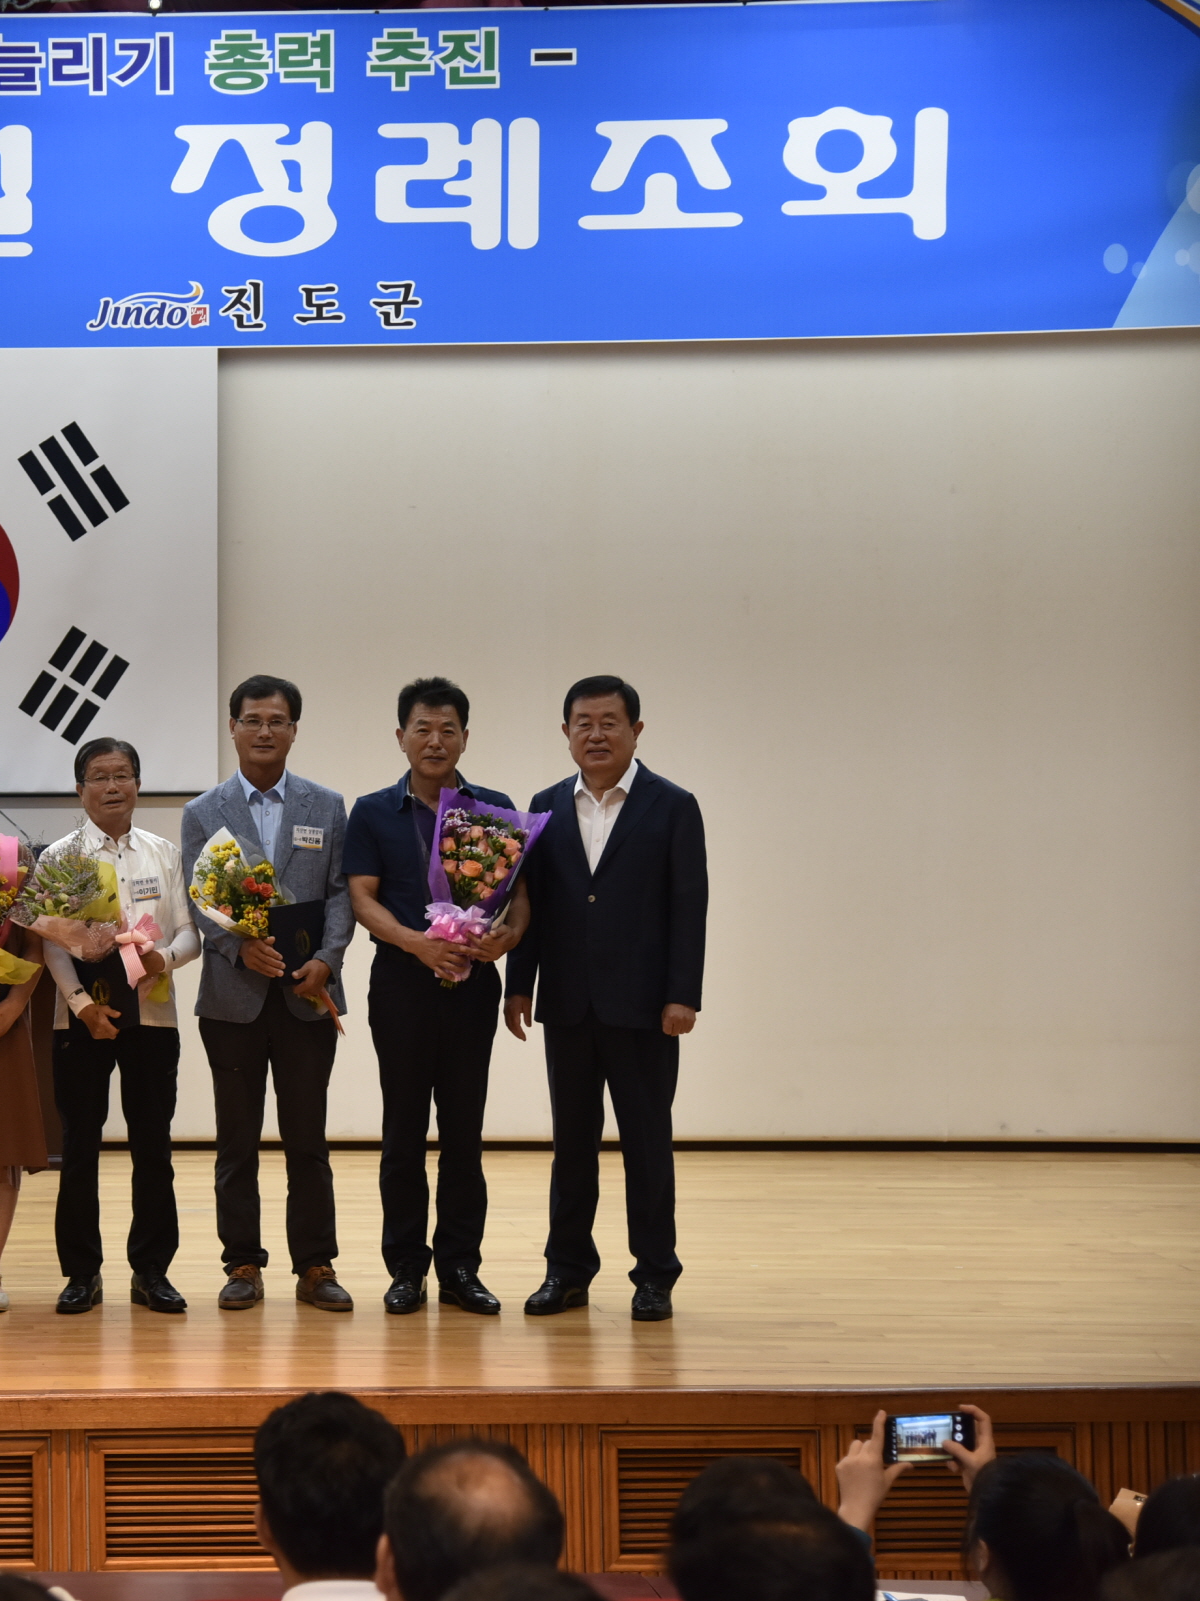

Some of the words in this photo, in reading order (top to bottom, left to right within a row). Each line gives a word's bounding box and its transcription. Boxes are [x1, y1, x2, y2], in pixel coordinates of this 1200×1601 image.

[205, 30, 334, 95] 총력
[367, 27, 500, 91] 추진
[171, 107, 948, 257] 정례조회
[87, 297, 189, 331] Jindo
